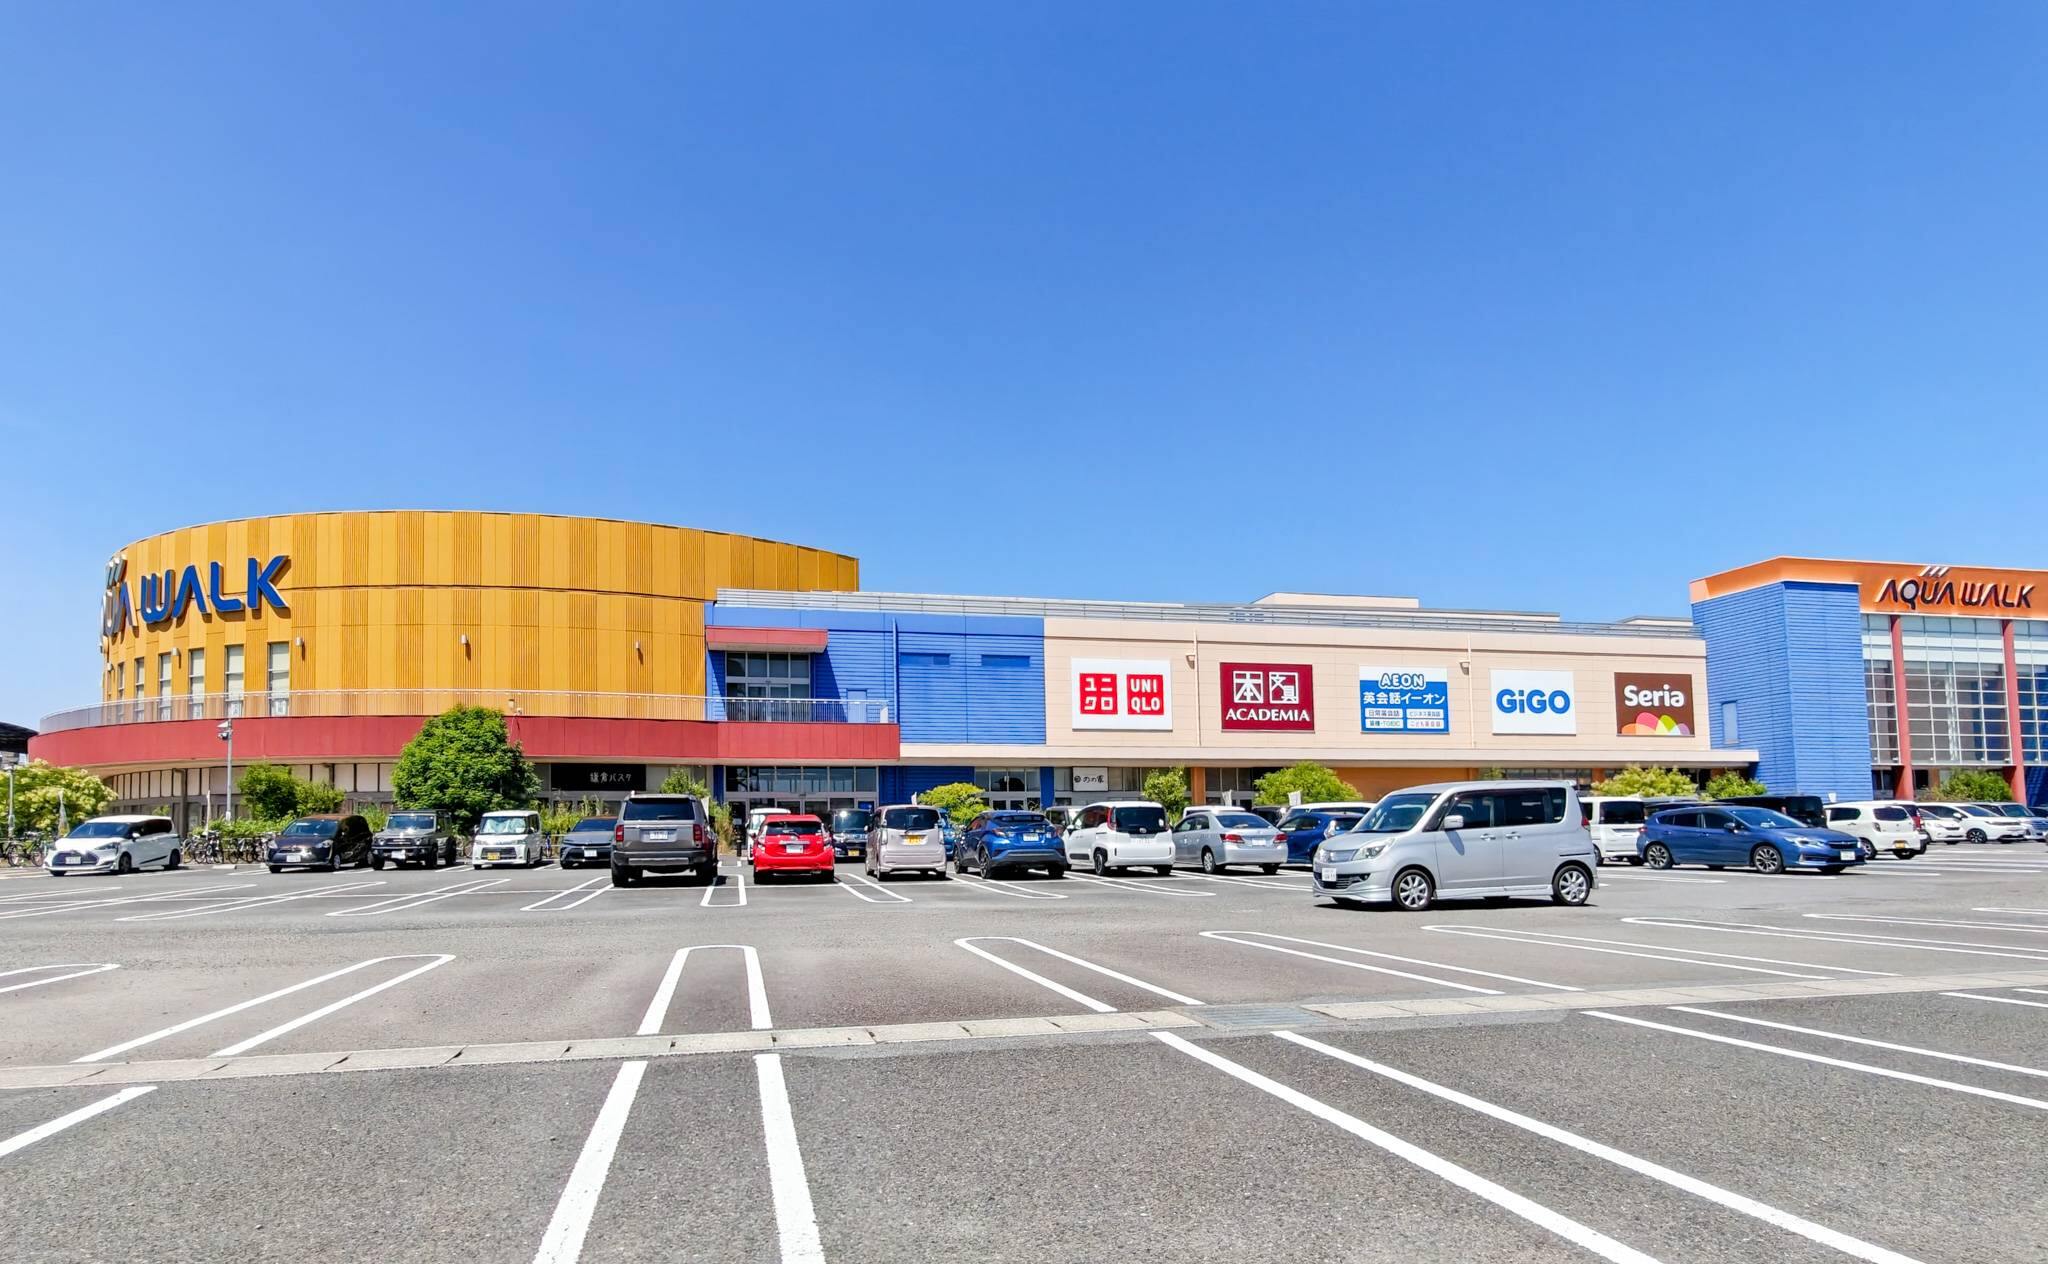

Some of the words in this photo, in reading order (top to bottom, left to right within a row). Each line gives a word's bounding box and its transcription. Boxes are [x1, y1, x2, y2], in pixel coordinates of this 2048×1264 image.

[140, 555, 290, 624] WALK
[1876, 578, 1955, 610] AQUA
[1960, 582, 2036, 609] WALK
[1084, 677, 1114, 692] ユニ
[1130, 678, 1158, 693] UNI
[1380, 672, 1425, 688] AEON
[1084, 696, 1114, 711] クロ
[1363, 691, 1446, 705] 英会話イーオン
[1496, 688, 1571, 715] GiGO
[1623, 684, 1685, 708] Seria
[1130, 697, 1161, 713] QLO
[1225, 708, 1310, 722] ACADEMIA
